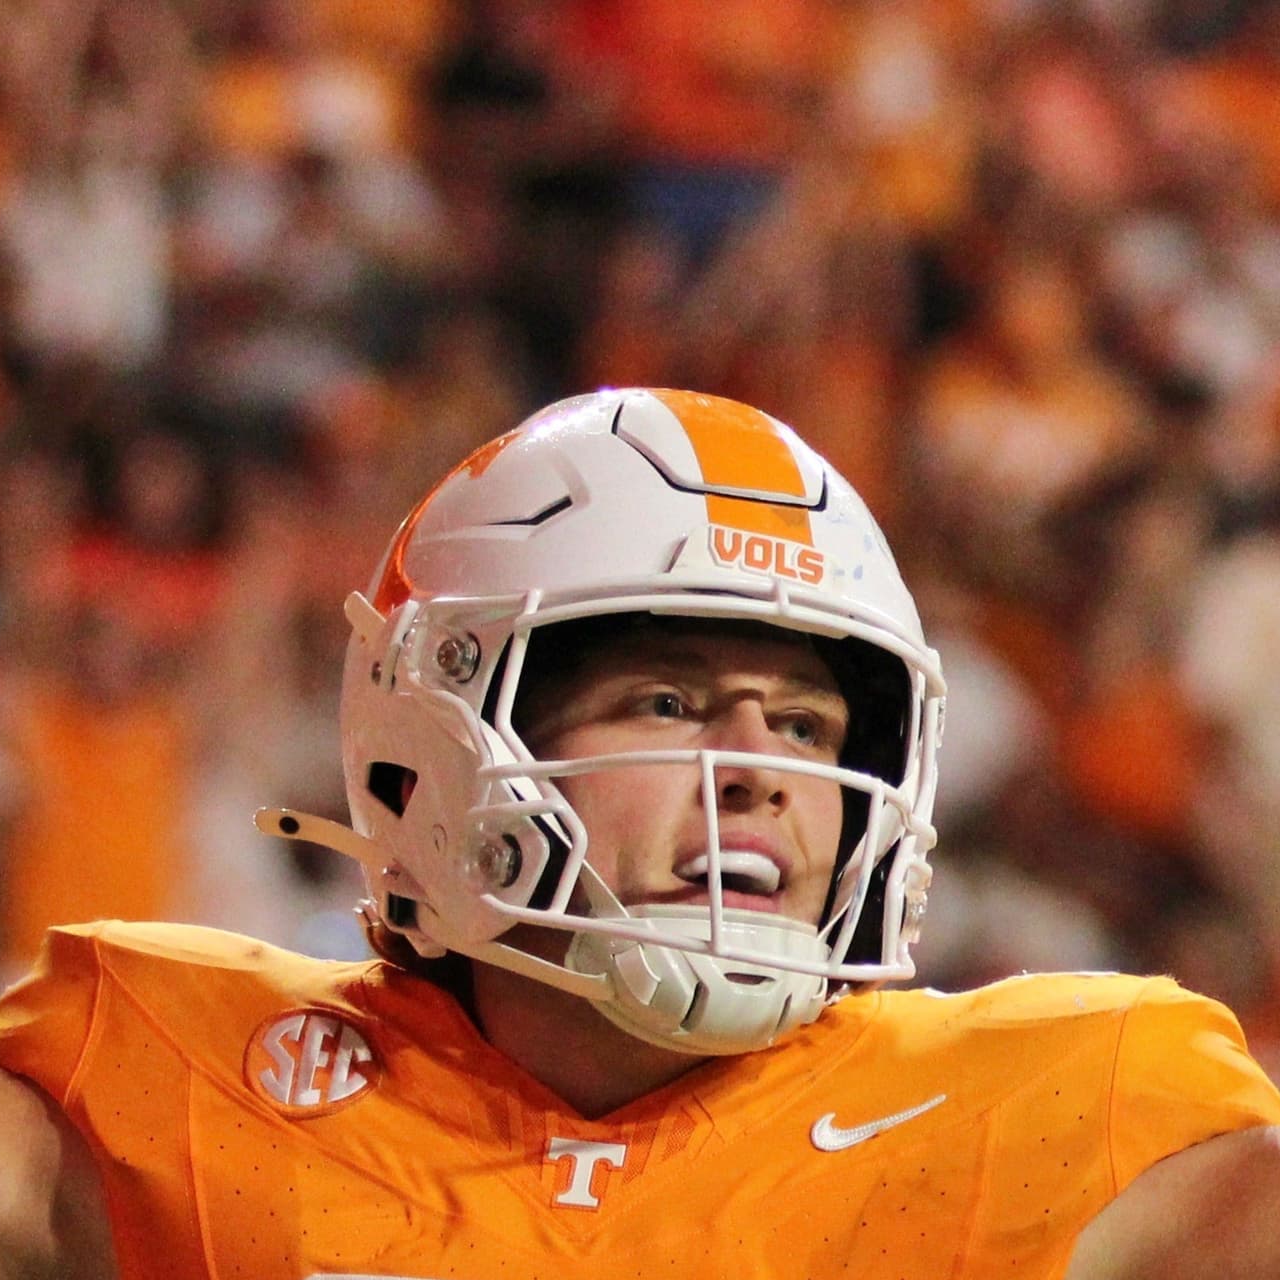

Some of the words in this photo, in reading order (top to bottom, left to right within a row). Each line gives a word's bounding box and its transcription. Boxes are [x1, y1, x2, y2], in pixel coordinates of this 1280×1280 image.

[713, 528, 825, 586] VOLS
[258, 1014, 372, 1106] SEC
[549, 1136, 627, 1208] T
